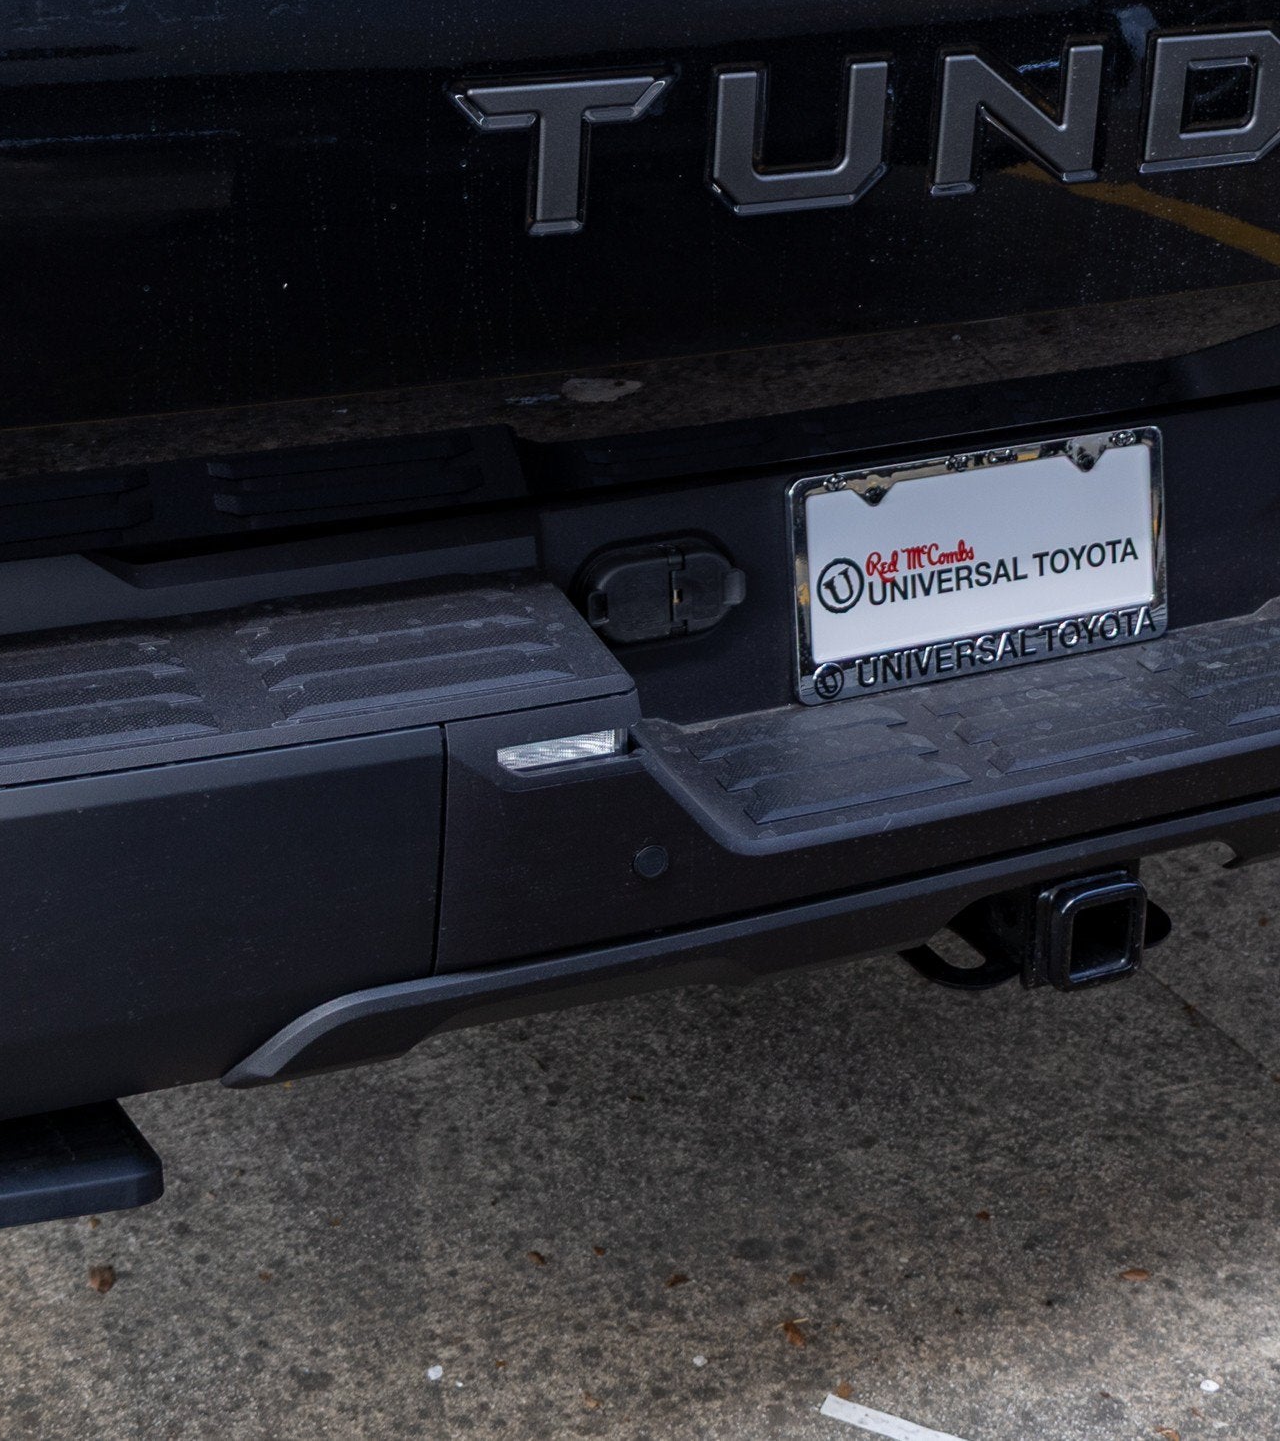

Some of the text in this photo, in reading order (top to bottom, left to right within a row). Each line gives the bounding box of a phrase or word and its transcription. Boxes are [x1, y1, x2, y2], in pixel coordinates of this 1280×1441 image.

[865, 549, 899, 583] Red
[868, 537, 1139, 606] UNIVERSAL TOYOTA
[855, 605, 1158, 688] UNIVERSAL TOYOTA
